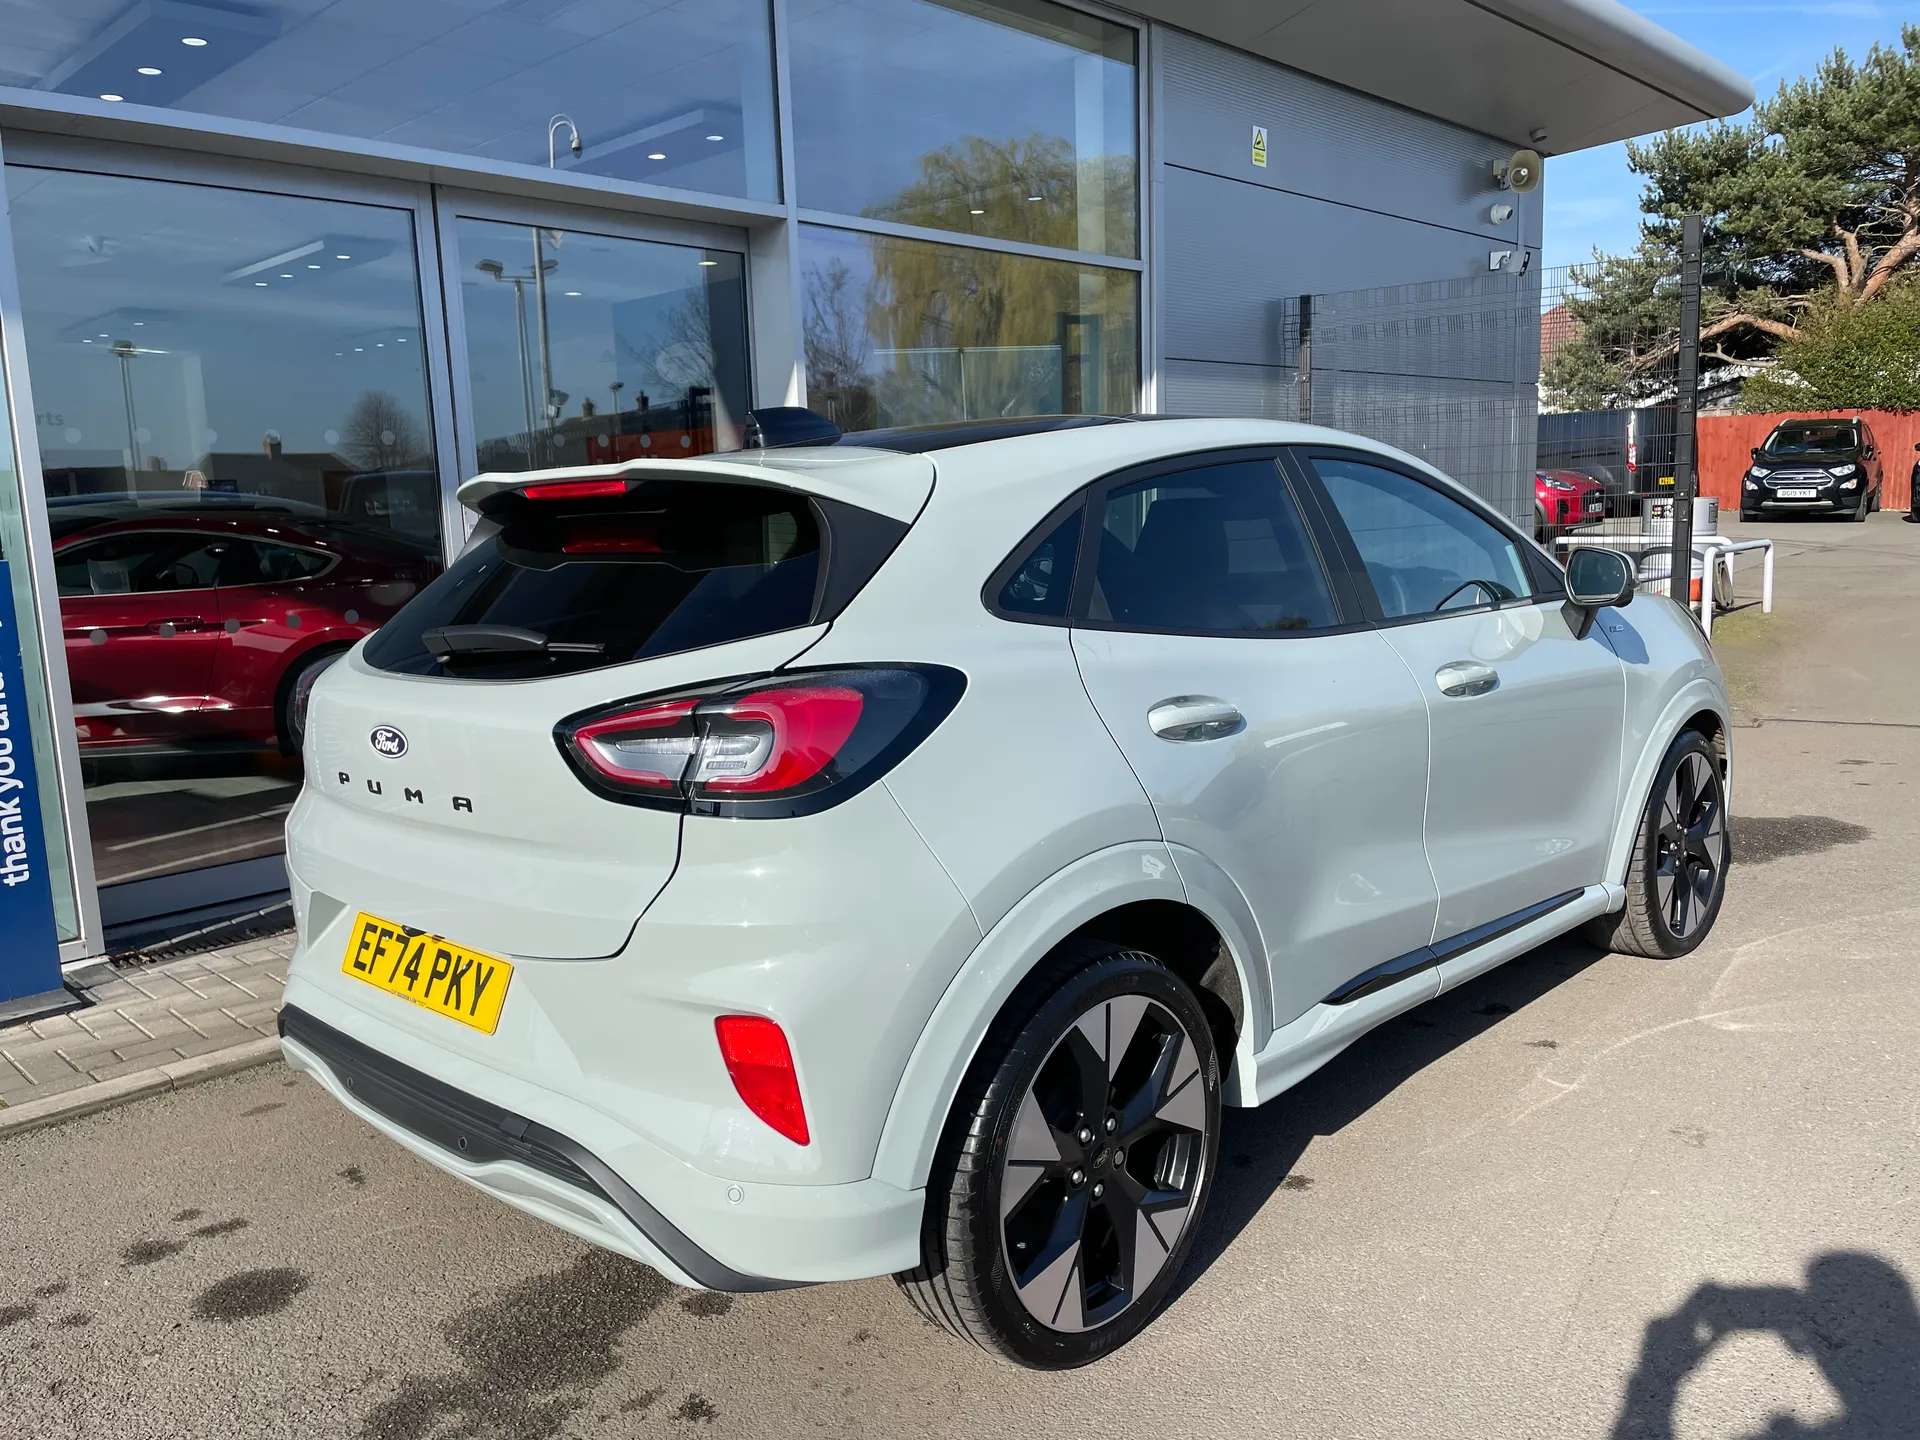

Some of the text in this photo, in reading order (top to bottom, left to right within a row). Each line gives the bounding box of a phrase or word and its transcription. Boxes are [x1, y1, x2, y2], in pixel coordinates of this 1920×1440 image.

[338, 771, 473, 813] PUMA
[0, 797, 30, 887] thank
[353, 922, 495, 1017] EF74 PKY
